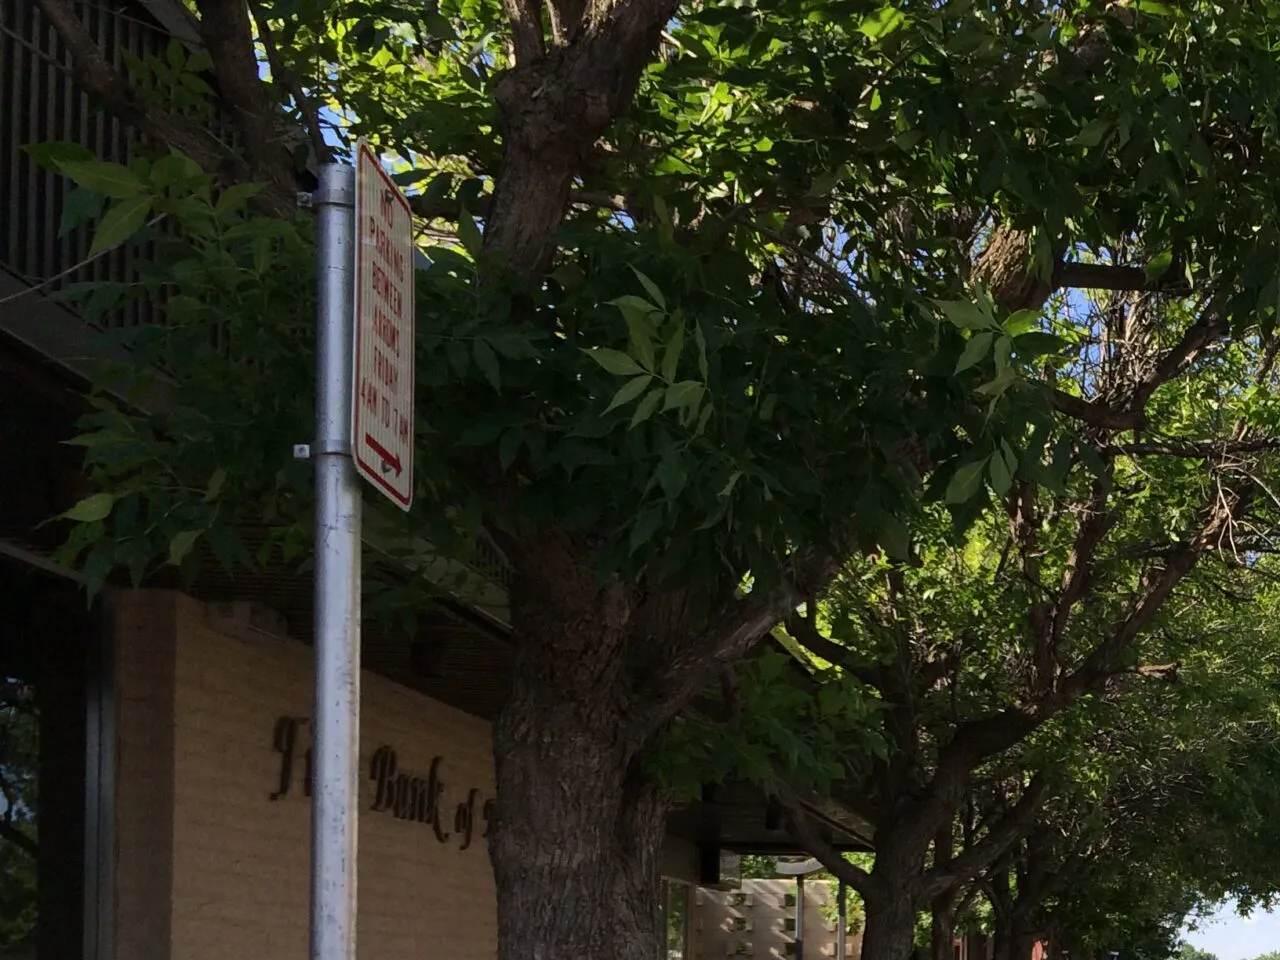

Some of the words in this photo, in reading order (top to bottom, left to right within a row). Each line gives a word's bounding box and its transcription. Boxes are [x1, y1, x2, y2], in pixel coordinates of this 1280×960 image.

[380, 189, 393, 229] NO
[369, 215, 404, 283] PARKING
[372, 260, 402, 319] BETWEEN
[373, 305, 400, 358] ARROWS
[374, 345, 399, 394] FRIDAY
[382, 395, 391, 429] TO
[369, 745, 449, 843] Bank
[455, 788, 480, 851] of
